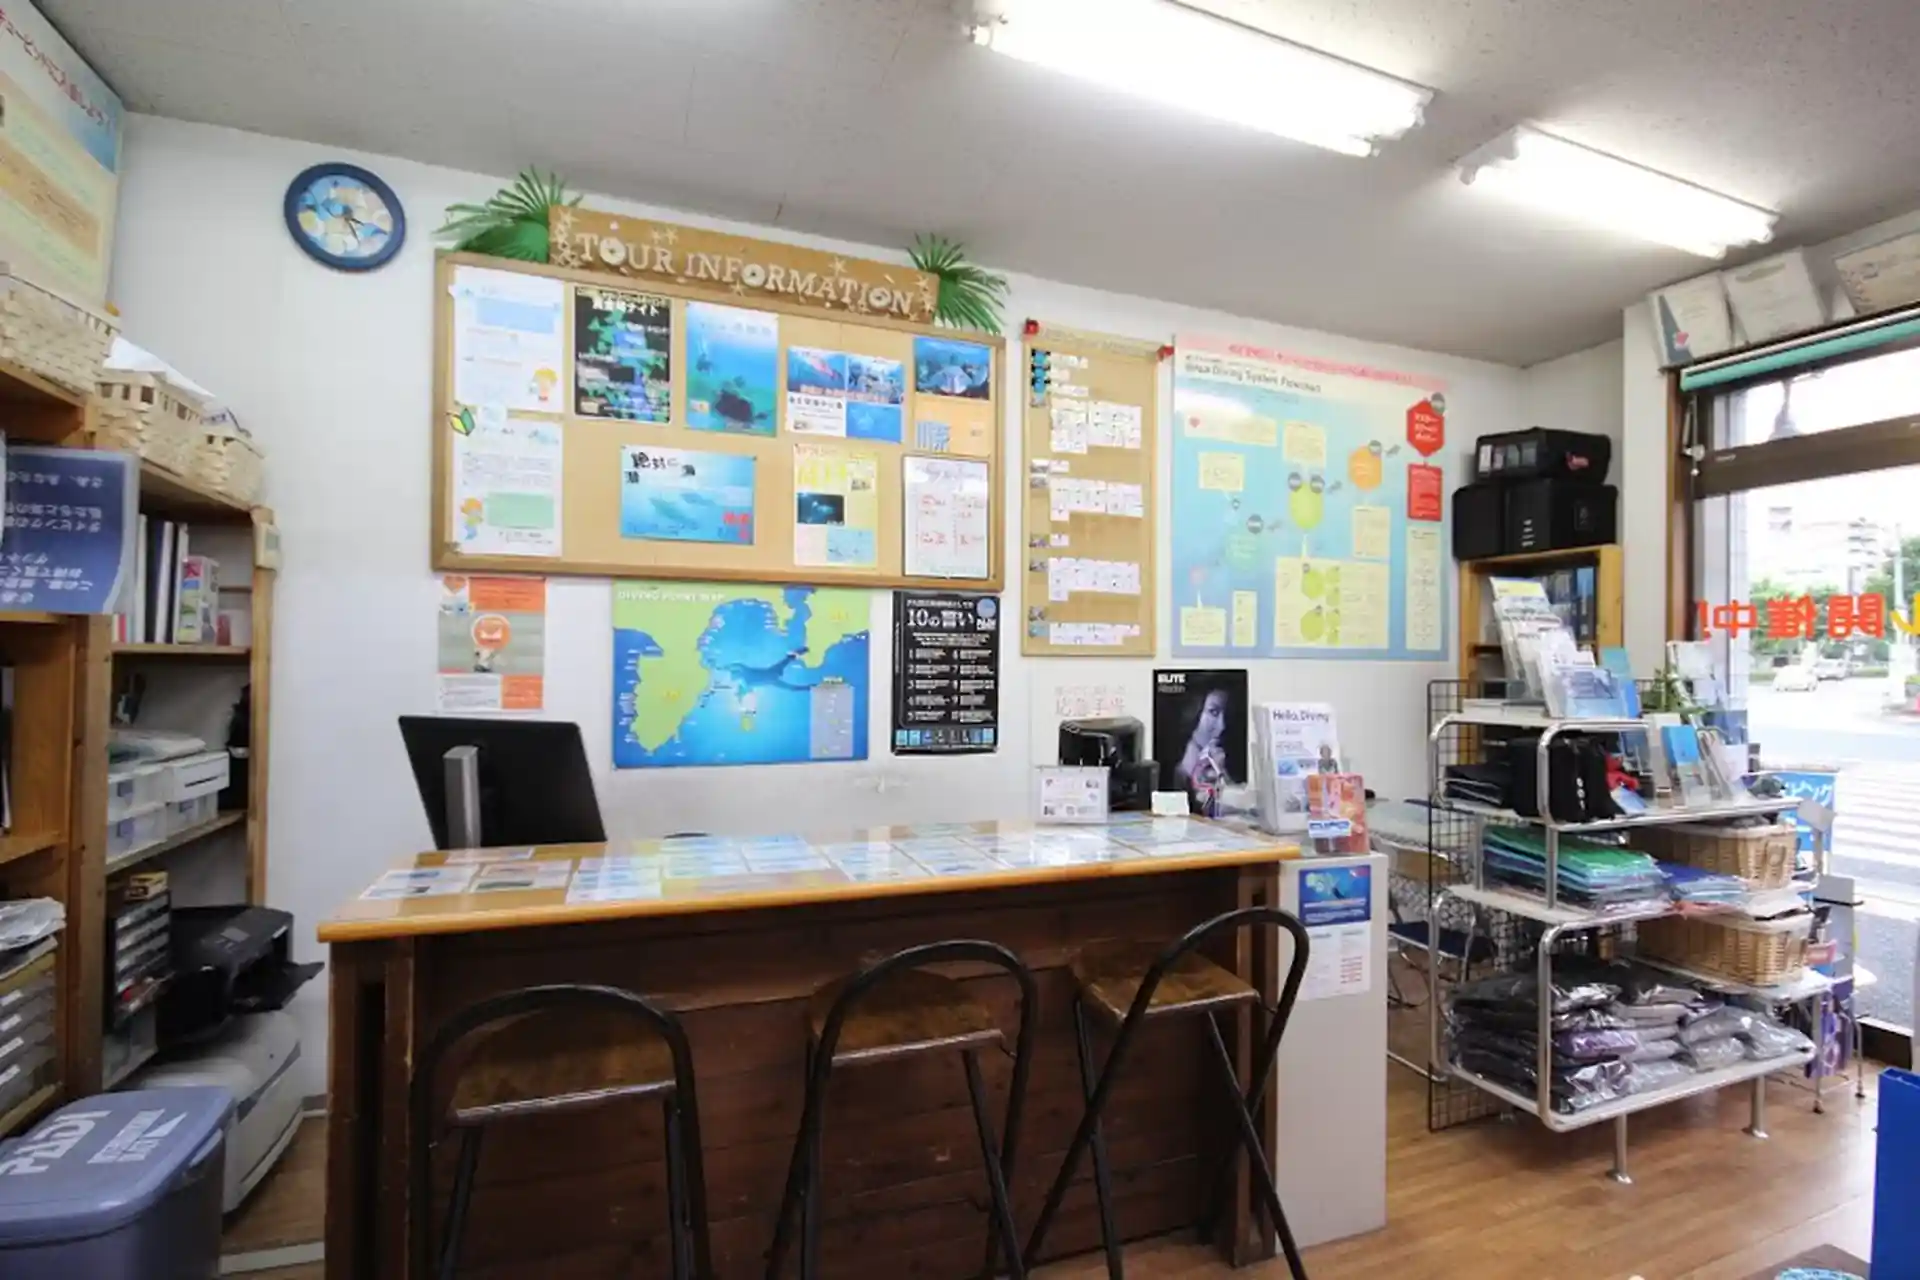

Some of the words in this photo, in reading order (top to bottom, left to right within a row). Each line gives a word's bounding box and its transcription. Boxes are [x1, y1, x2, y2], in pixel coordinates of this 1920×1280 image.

[575, 232, 674, 274] TOUR
[684, 253, 914, 315] INFORMATION
[1157, 673, 1186, 684] ELITE
